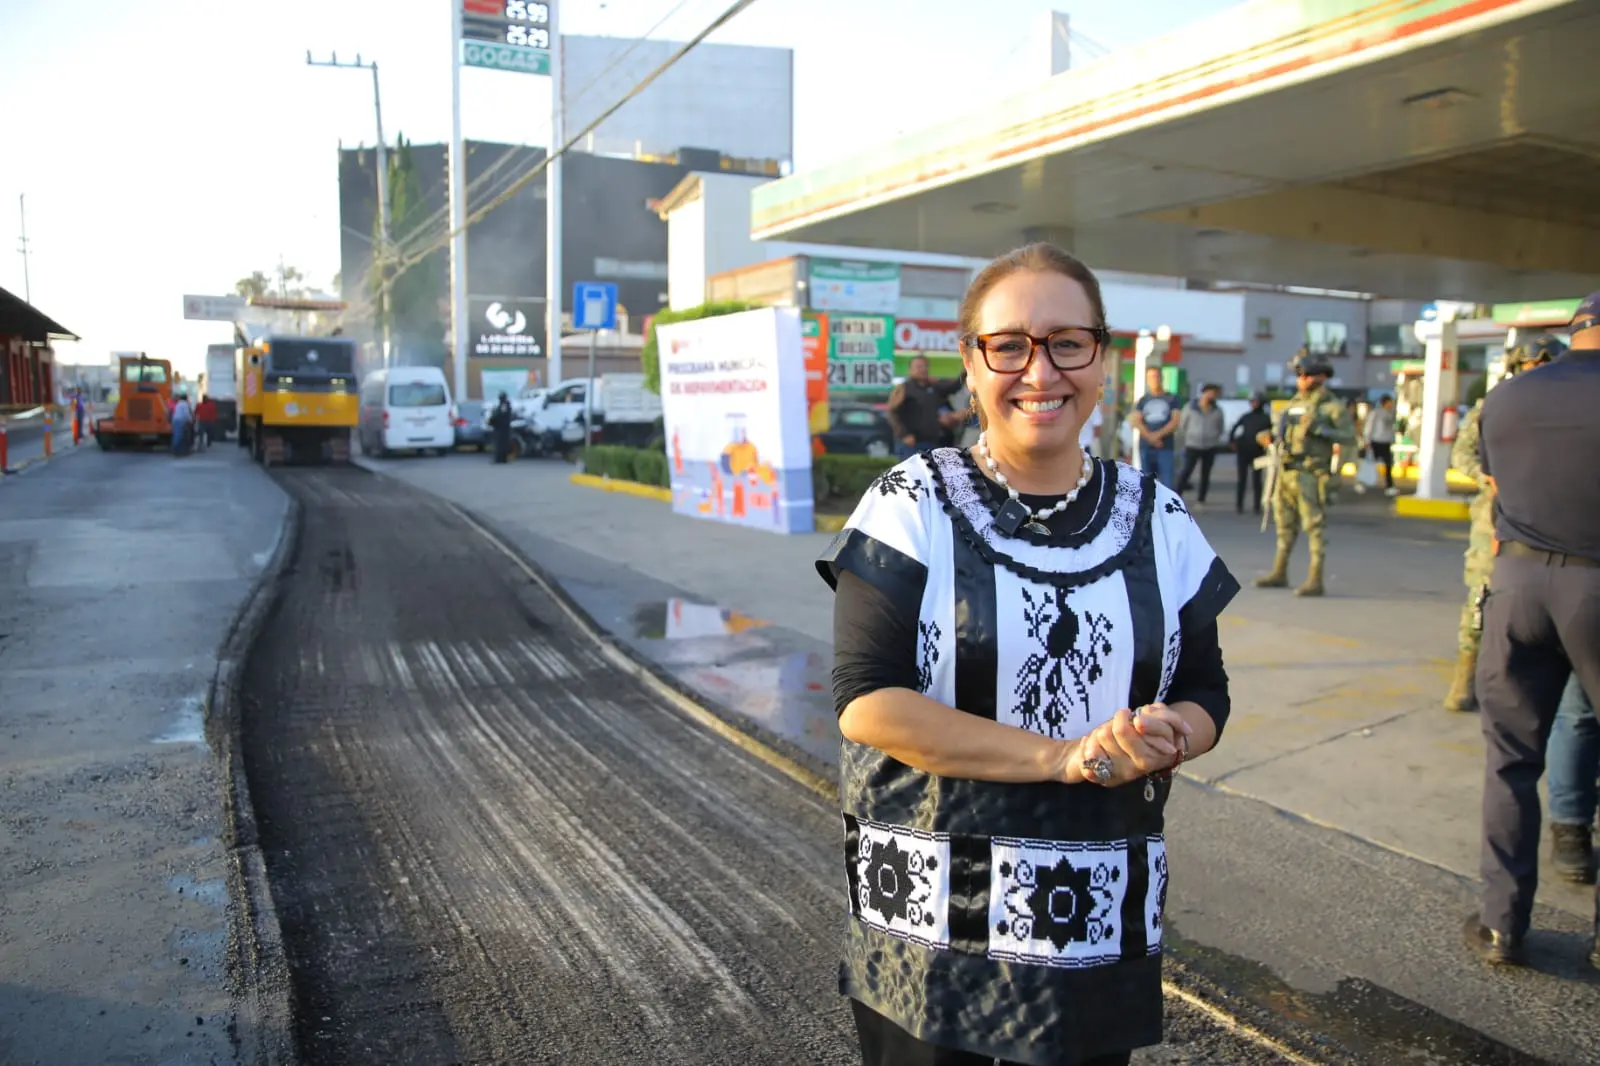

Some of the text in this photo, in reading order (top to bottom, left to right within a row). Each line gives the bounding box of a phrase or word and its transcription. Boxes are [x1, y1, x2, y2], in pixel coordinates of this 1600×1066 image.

[464, 45, 542, 72] GOGAS
[831, 320, 865, 334] VENTA
[869, 321, 882, 334] DE
[838, 340, 875, 353] DIESEL
[828, 363, 847, 384] 24
[853, 363, 892, 385] HRS
